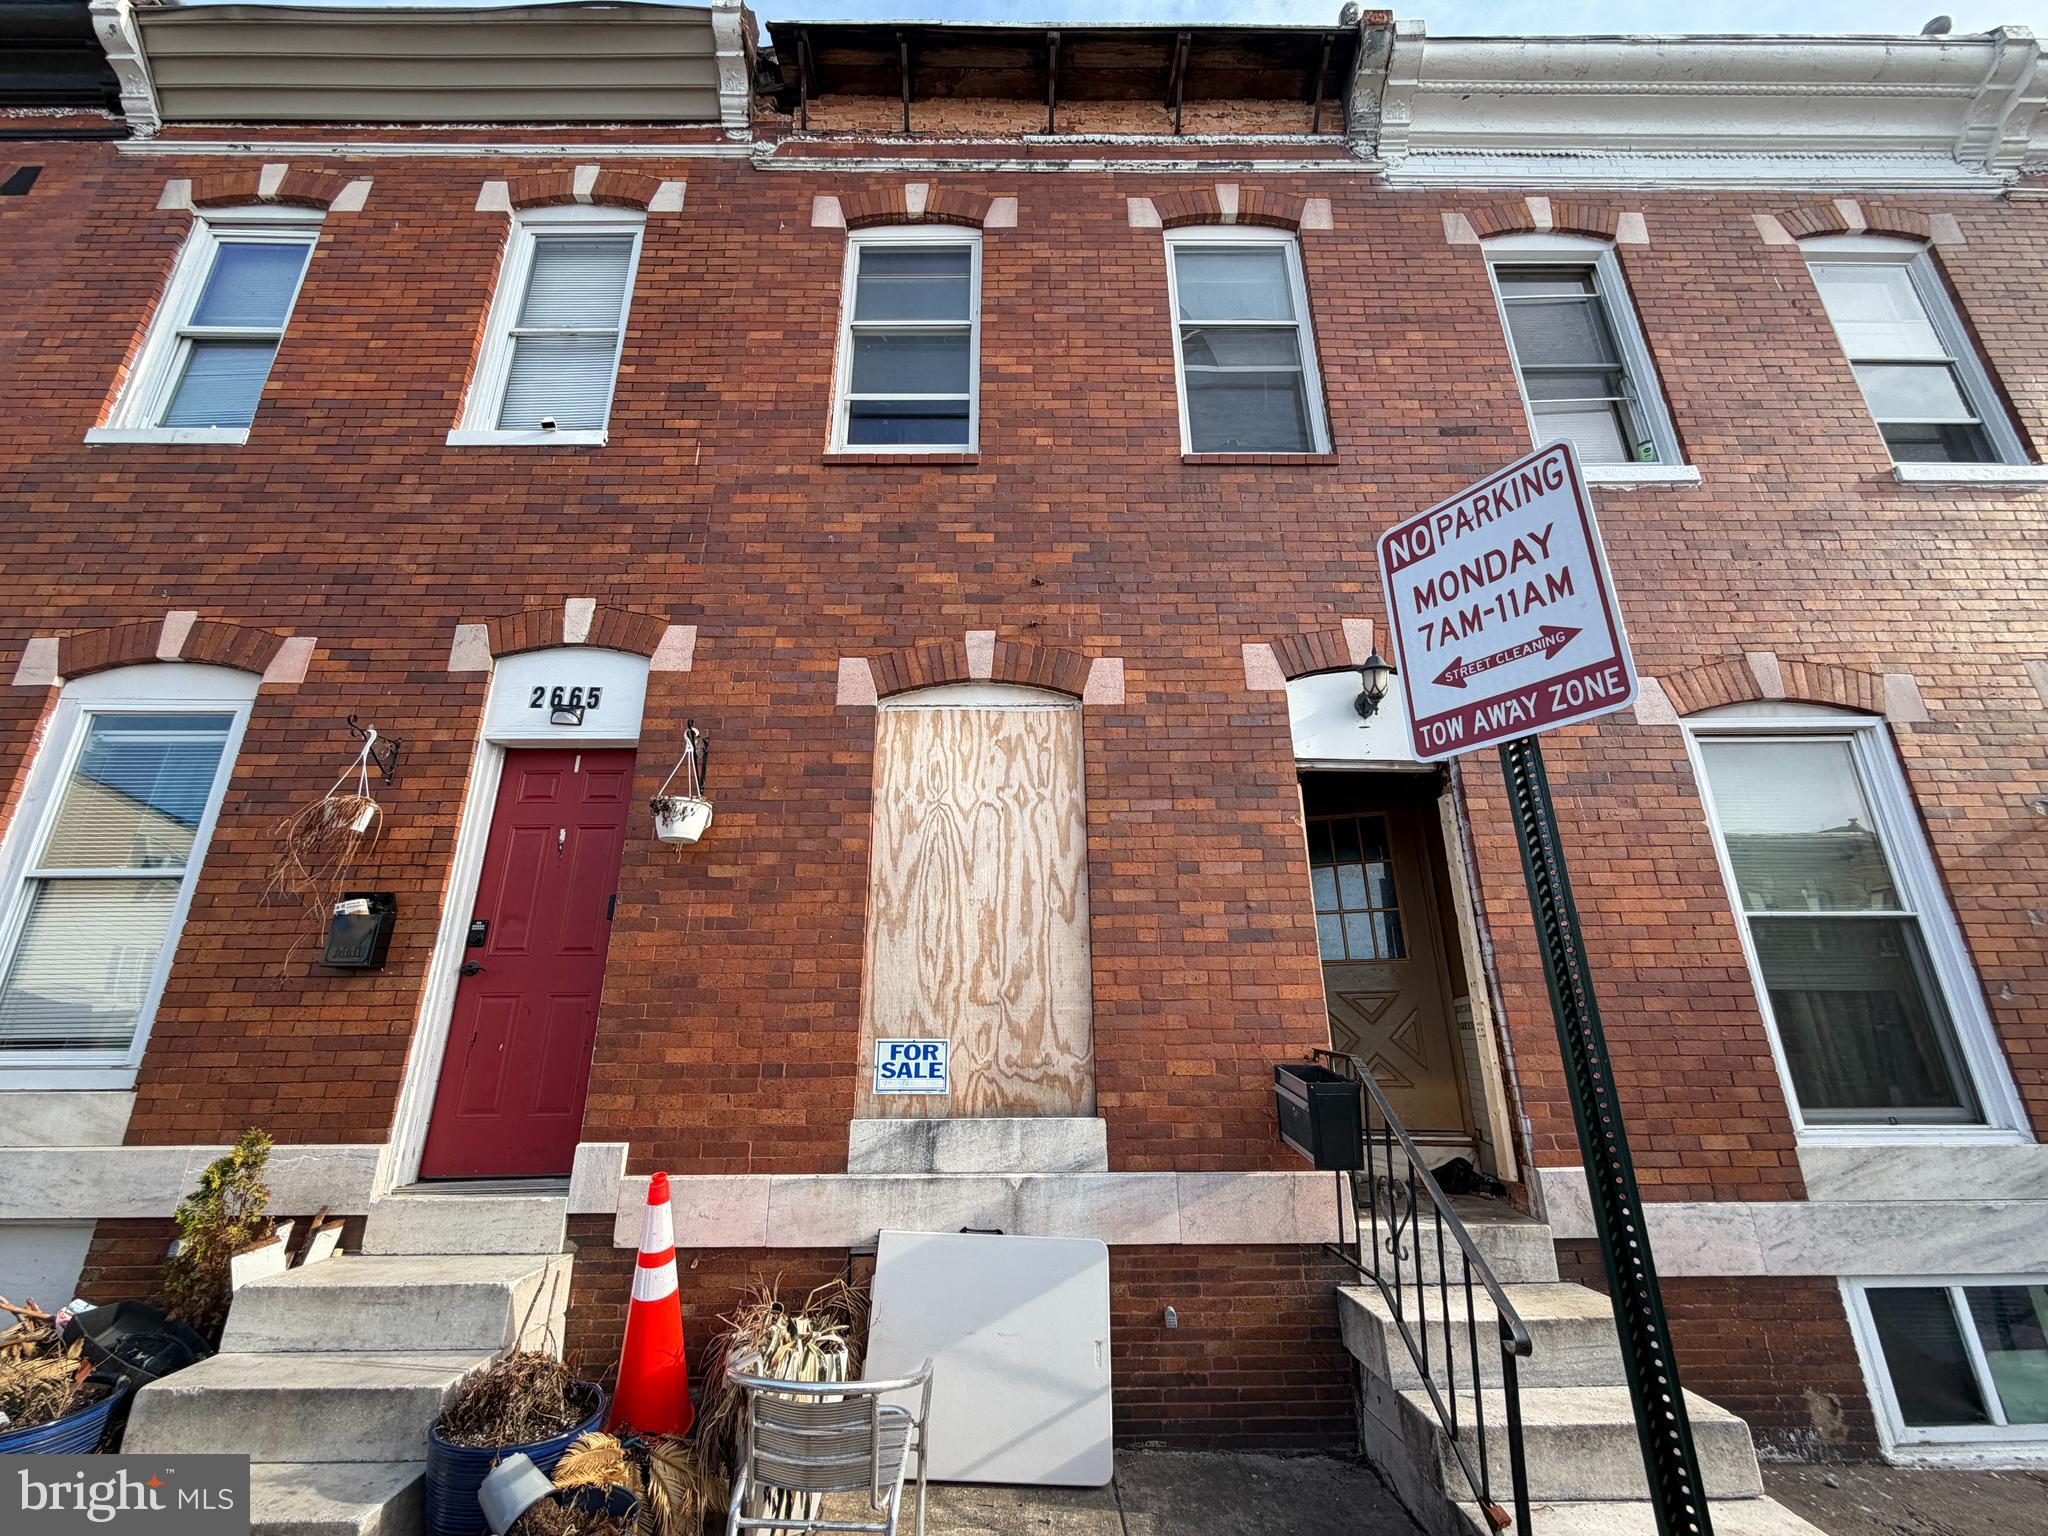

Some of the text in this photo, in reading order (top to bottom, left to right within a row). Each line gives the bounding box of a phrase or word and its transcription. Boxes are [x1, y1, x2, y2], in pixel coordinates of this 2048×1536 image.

[1388, 456, 1565, 568] NO PARKING
[1412, 522, 1554, 614] MONDAY
[1417, 565, 1575, 652] 7AM-11AM
[1445, 631, 1566, 682] STREET CLEANING
[529, 686, 601, 709] 2665
[1419, 666, 1625, 750] TOW AWAY ZONE
[880, 1062, 943, 1079] SALE
[890, 1044, 939, 1061] FOR
